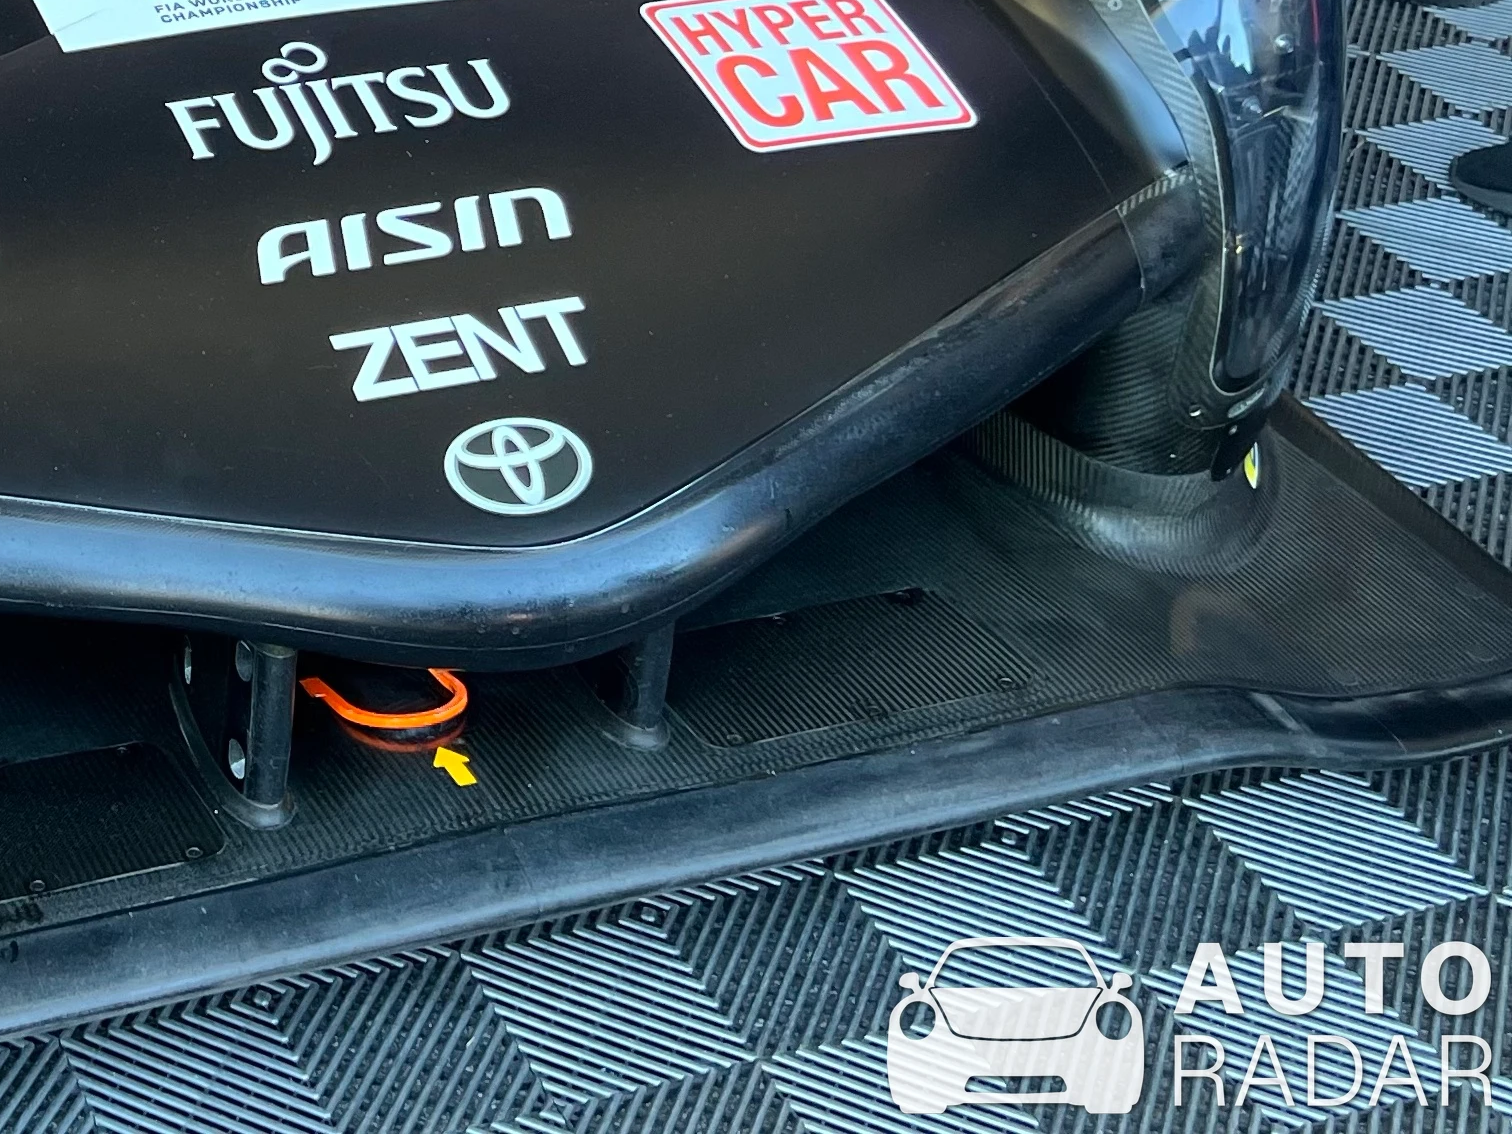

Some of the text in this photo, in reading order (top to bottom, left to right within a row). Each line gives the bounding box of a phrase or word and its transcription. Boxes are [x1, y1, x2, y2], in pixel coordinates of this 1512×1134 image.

[154, 2, 186, 14] FIA
[164, 42, 511, 165] FUJITSU
[715, 40, 948, 127] CAR
[257, 186, 574, 285] AISIN
[328, 296, 588, 402] ZENT
